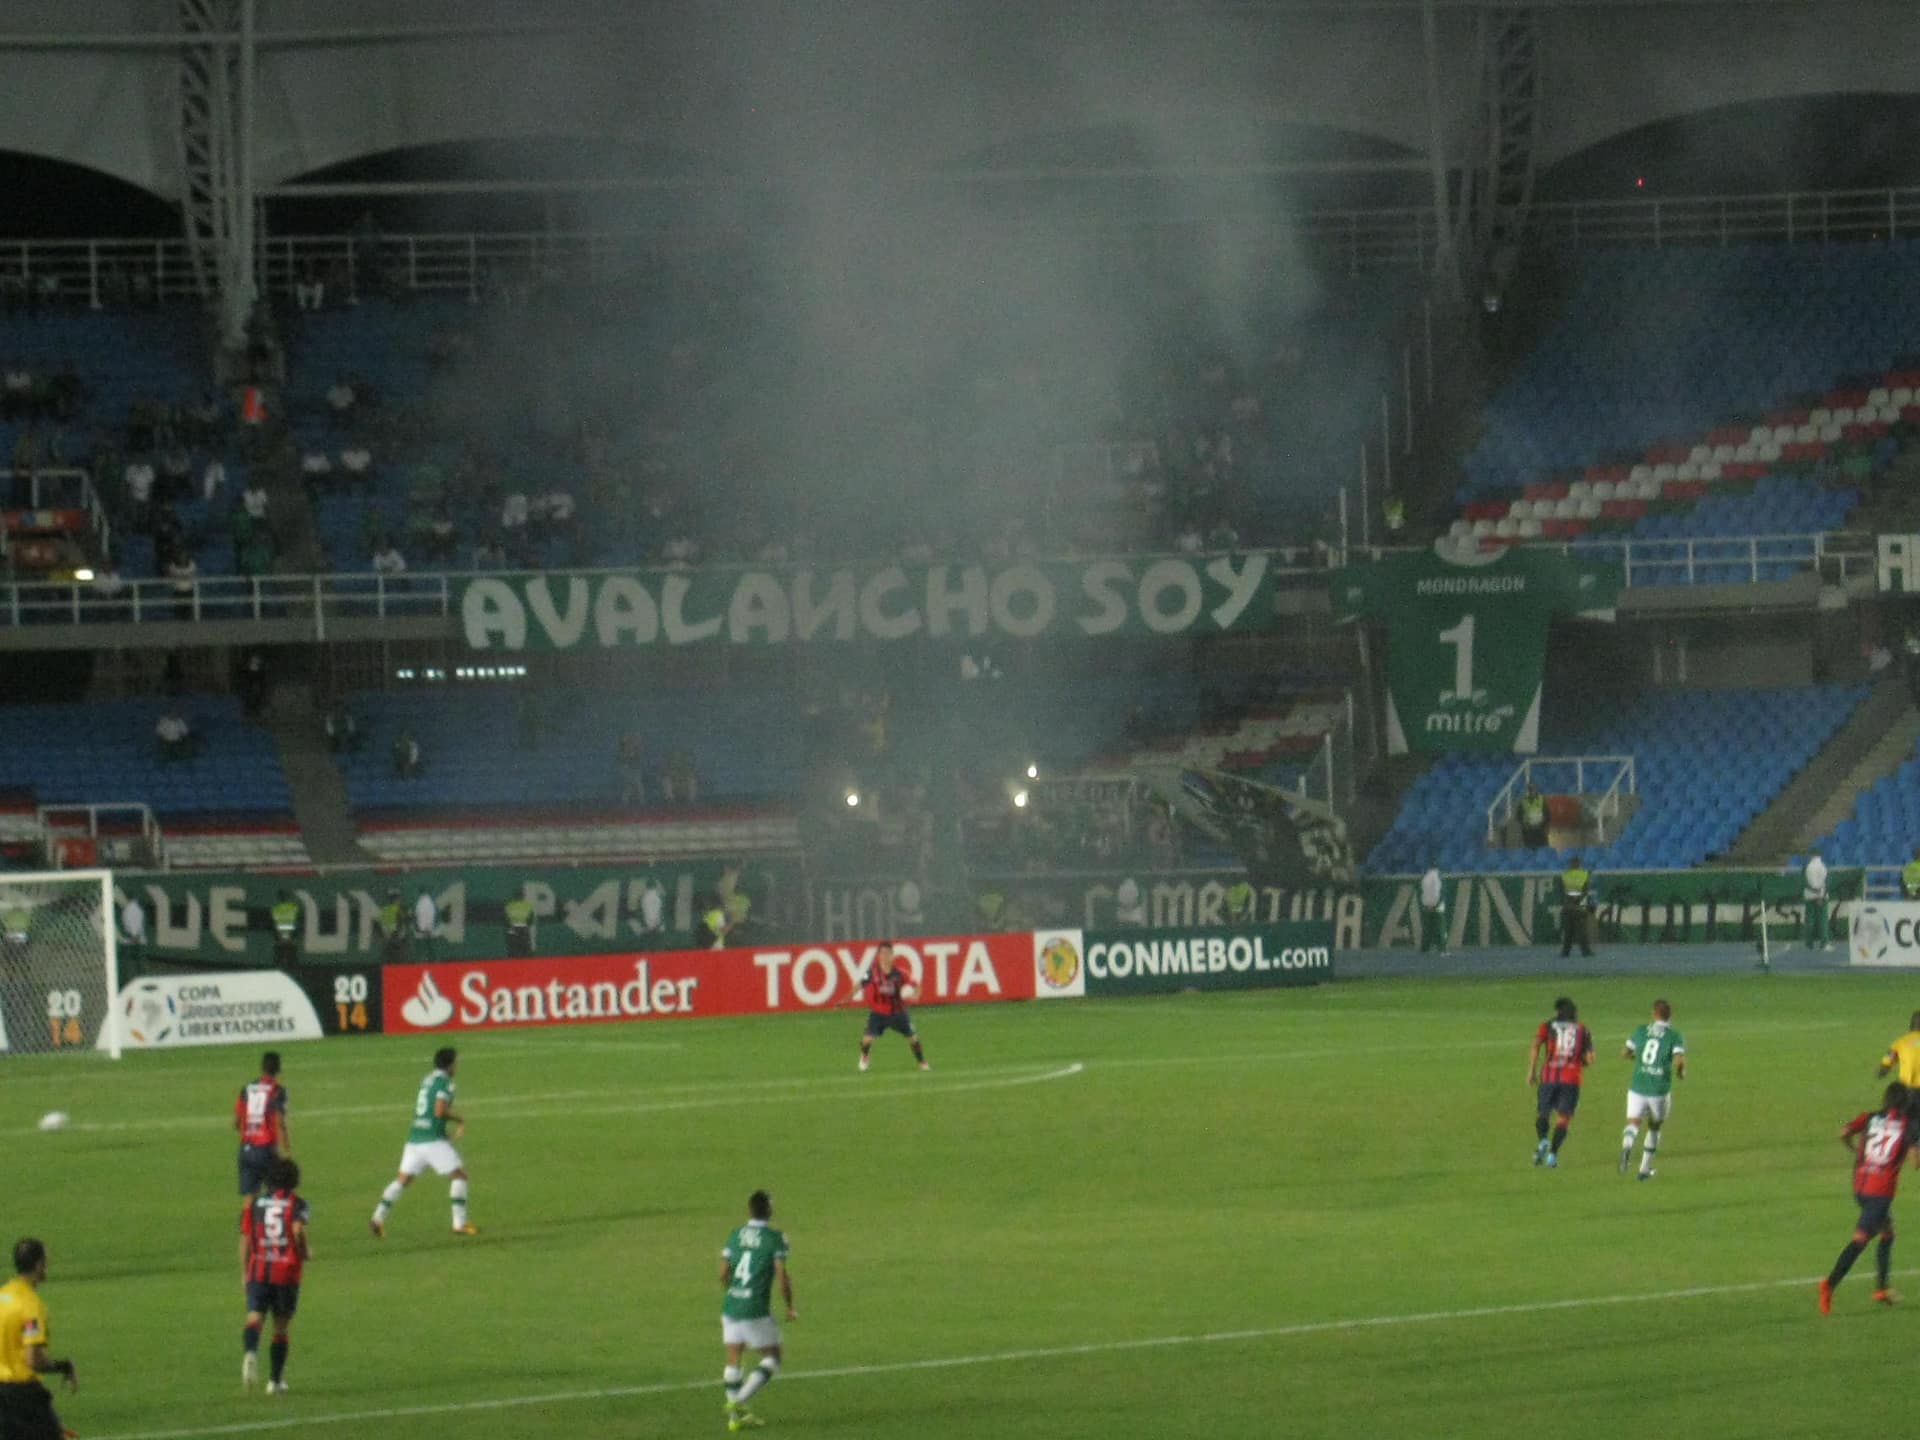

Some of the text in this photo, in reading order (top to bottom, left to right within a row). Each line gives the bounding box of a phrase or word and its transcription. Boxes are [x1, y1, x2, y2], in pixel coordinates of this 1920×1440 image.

[1075, 552, 1270, 635] SOY
[1417, 576, 1525, 594] MONDRAGON
[1440, 614, 1474, 699] 1
[1425, 708, 1502, 734] mitre
[1087, 936, 1328, 978] CONMEBOL.com
[334, 974, 368, 1003] 20
[753, 941, 1002, 1007] TOYOTA
[178, 985, 221, 1001] COPA
[460, 958, 698, 1024] Santander
[178, 1017, 296, 1037] LIBERTADORES
[335, 1002, 368, 1030] 14
[1641, 1038, 1660, 1065] 8
[1864, 1127, 1901, 1165] 27
[264, 1206, 283, 1239] 5
[734, 1250, 752, 1287] 4
